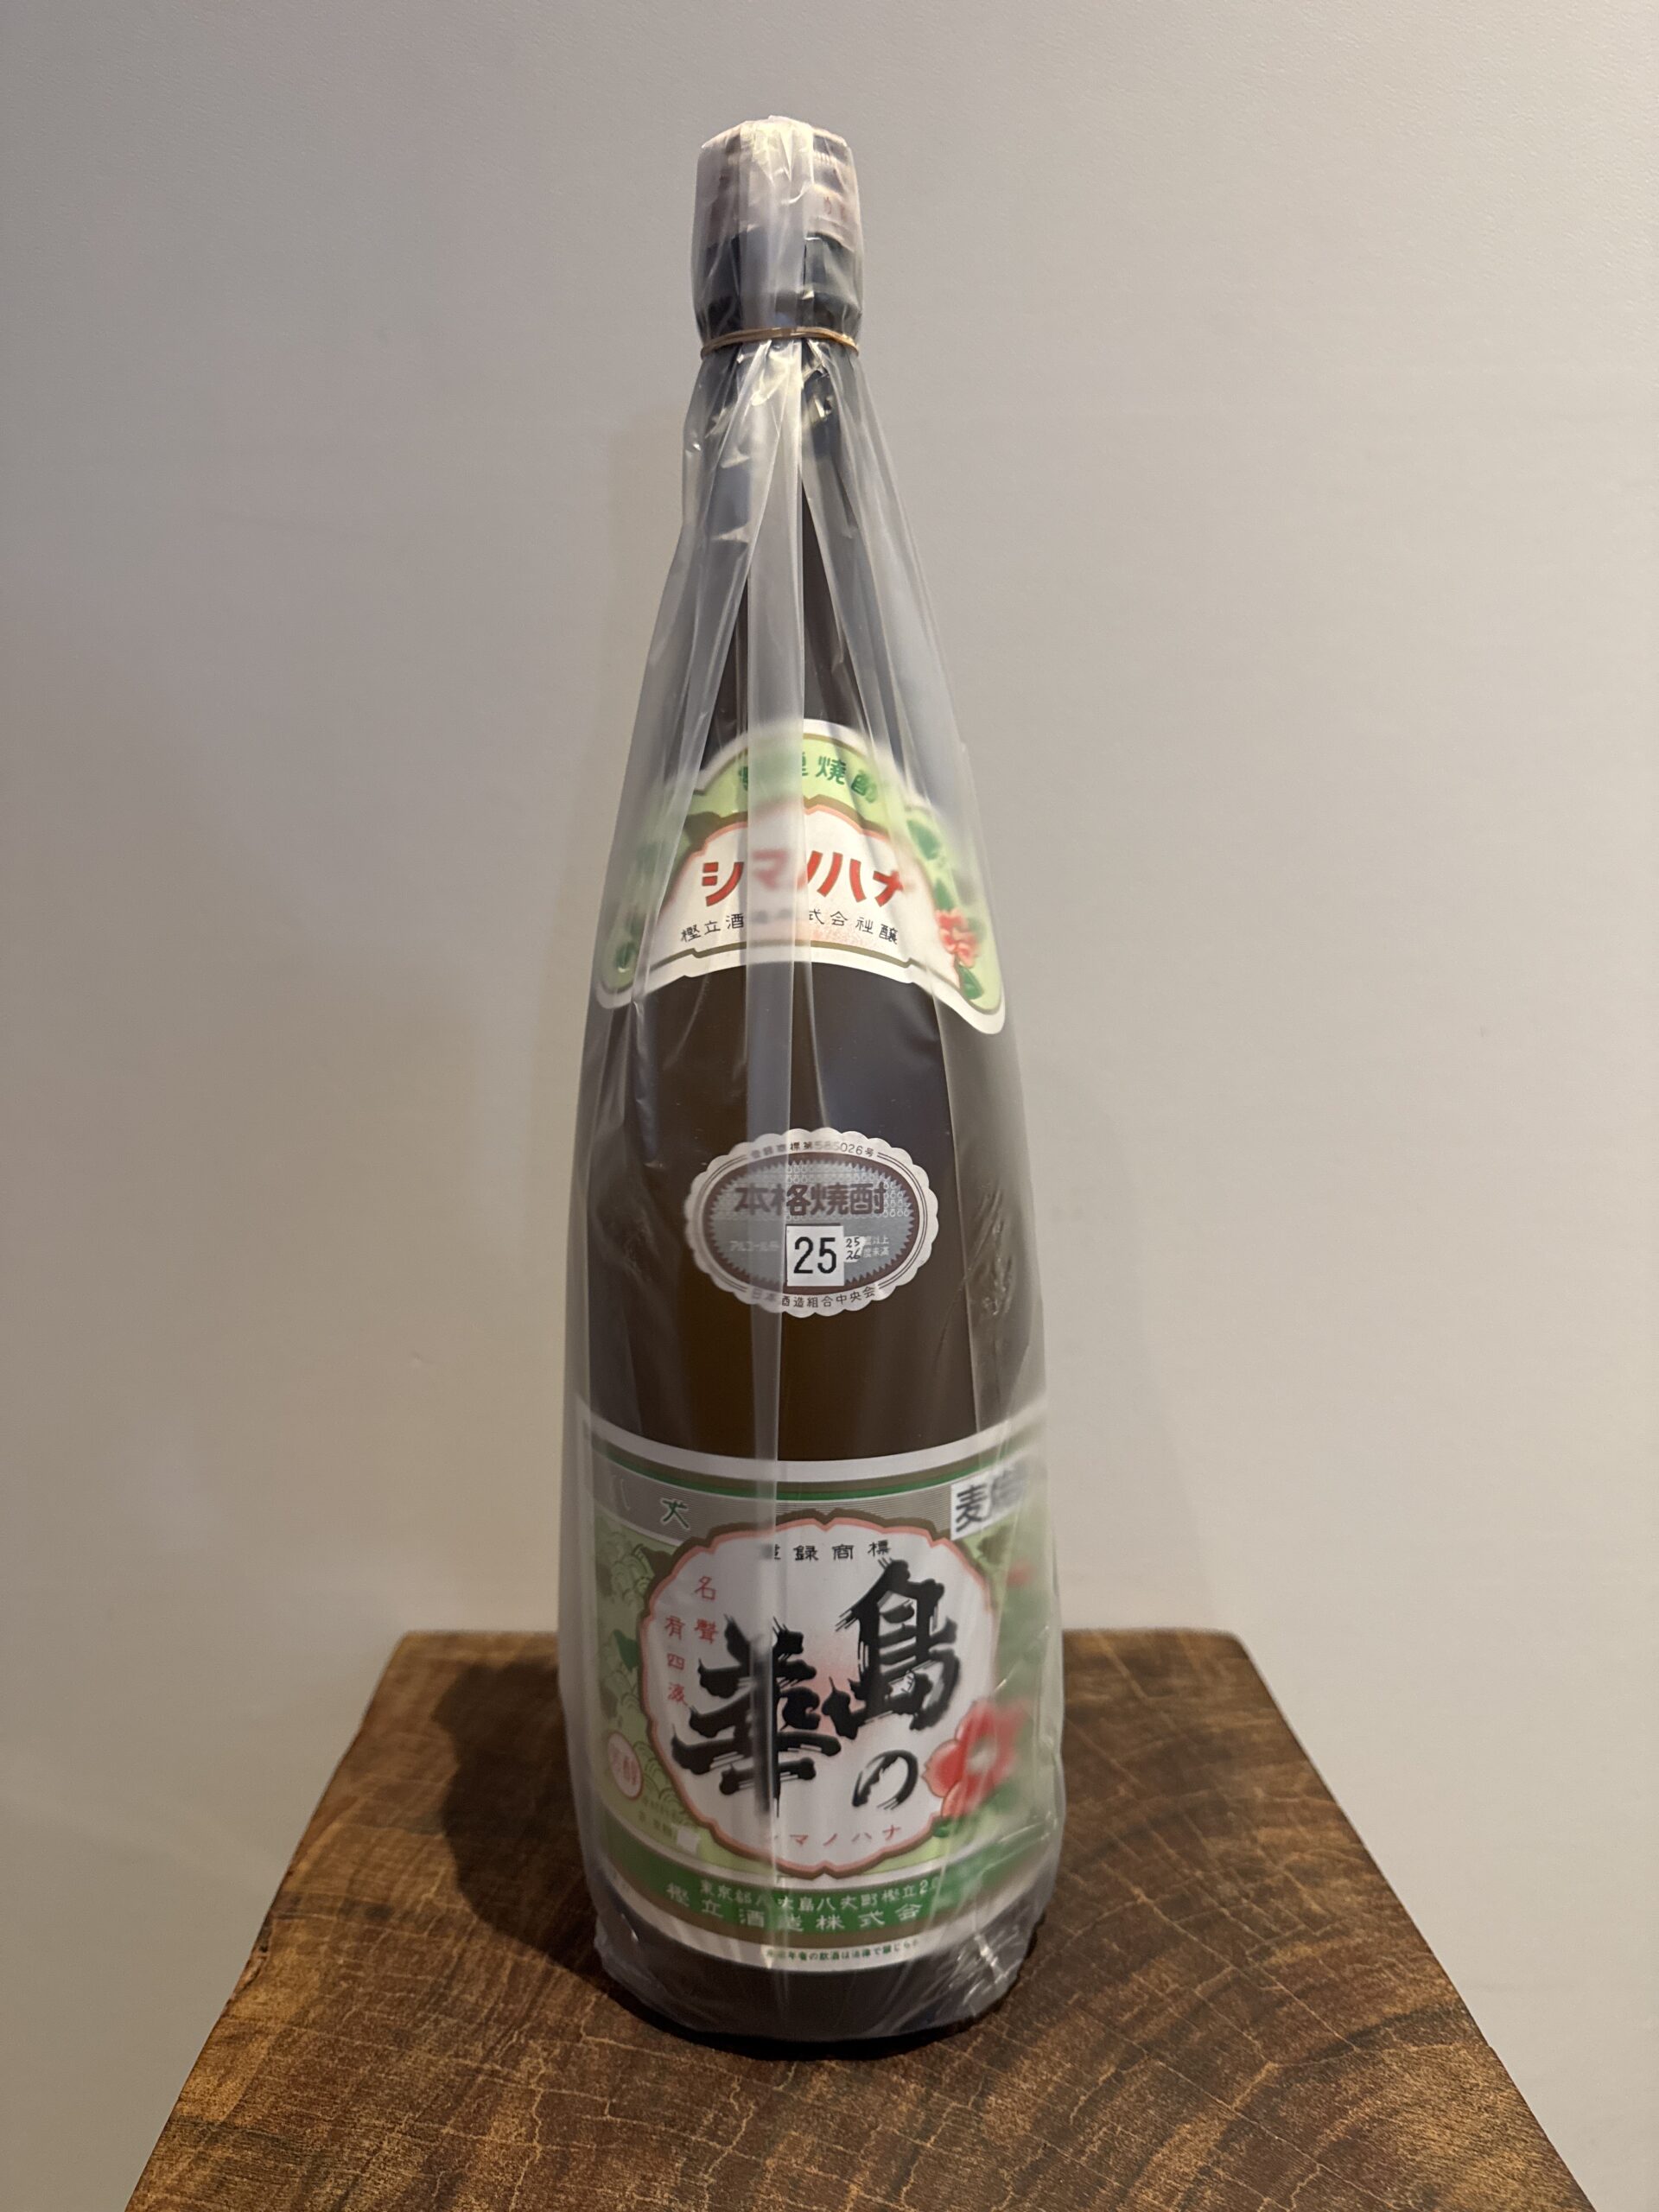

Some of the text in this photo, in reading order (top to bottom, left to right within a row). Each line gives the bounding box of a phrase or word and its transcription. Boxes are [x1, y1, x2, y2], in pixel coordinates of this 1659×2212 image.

[681, 908, 899, 945] 樫立酒式会社醸
[735, 1183, 887, 1216] 本格焼酎
[793, 1236, 837, 1274] 25
[775, 1825, 901, 1847] マノハナ
